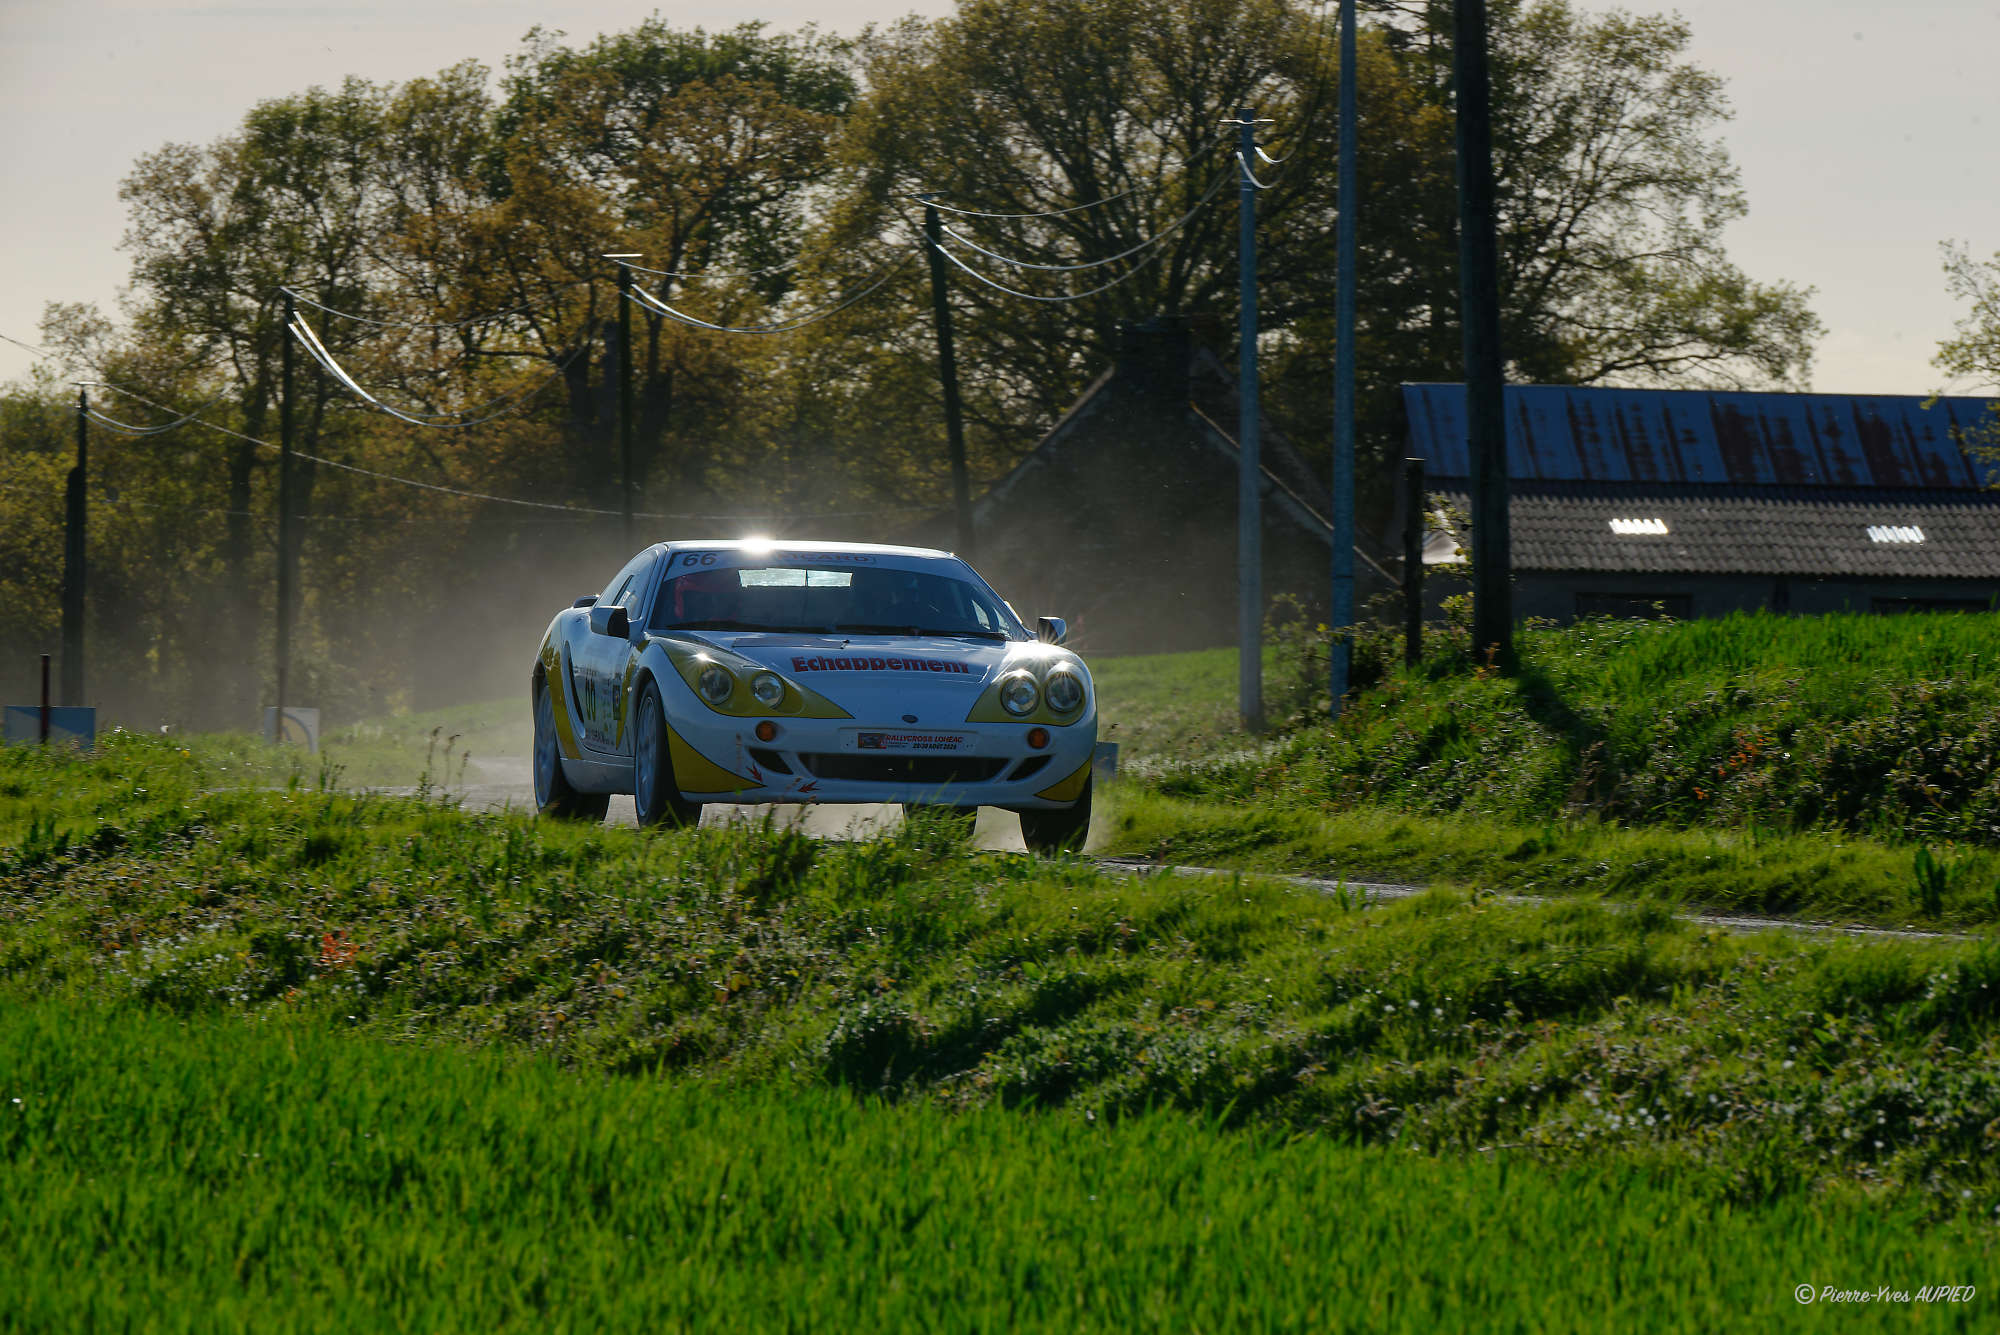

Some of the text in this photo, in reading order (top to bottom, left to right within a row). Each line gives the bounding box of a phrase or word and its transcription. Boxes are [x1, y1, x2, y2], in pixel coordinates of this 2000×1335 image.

[682, 552, 718, 567] 66
[791, 656, 970, 673] Echappement
[886, 735, 933, 743] RALLYCROSS
